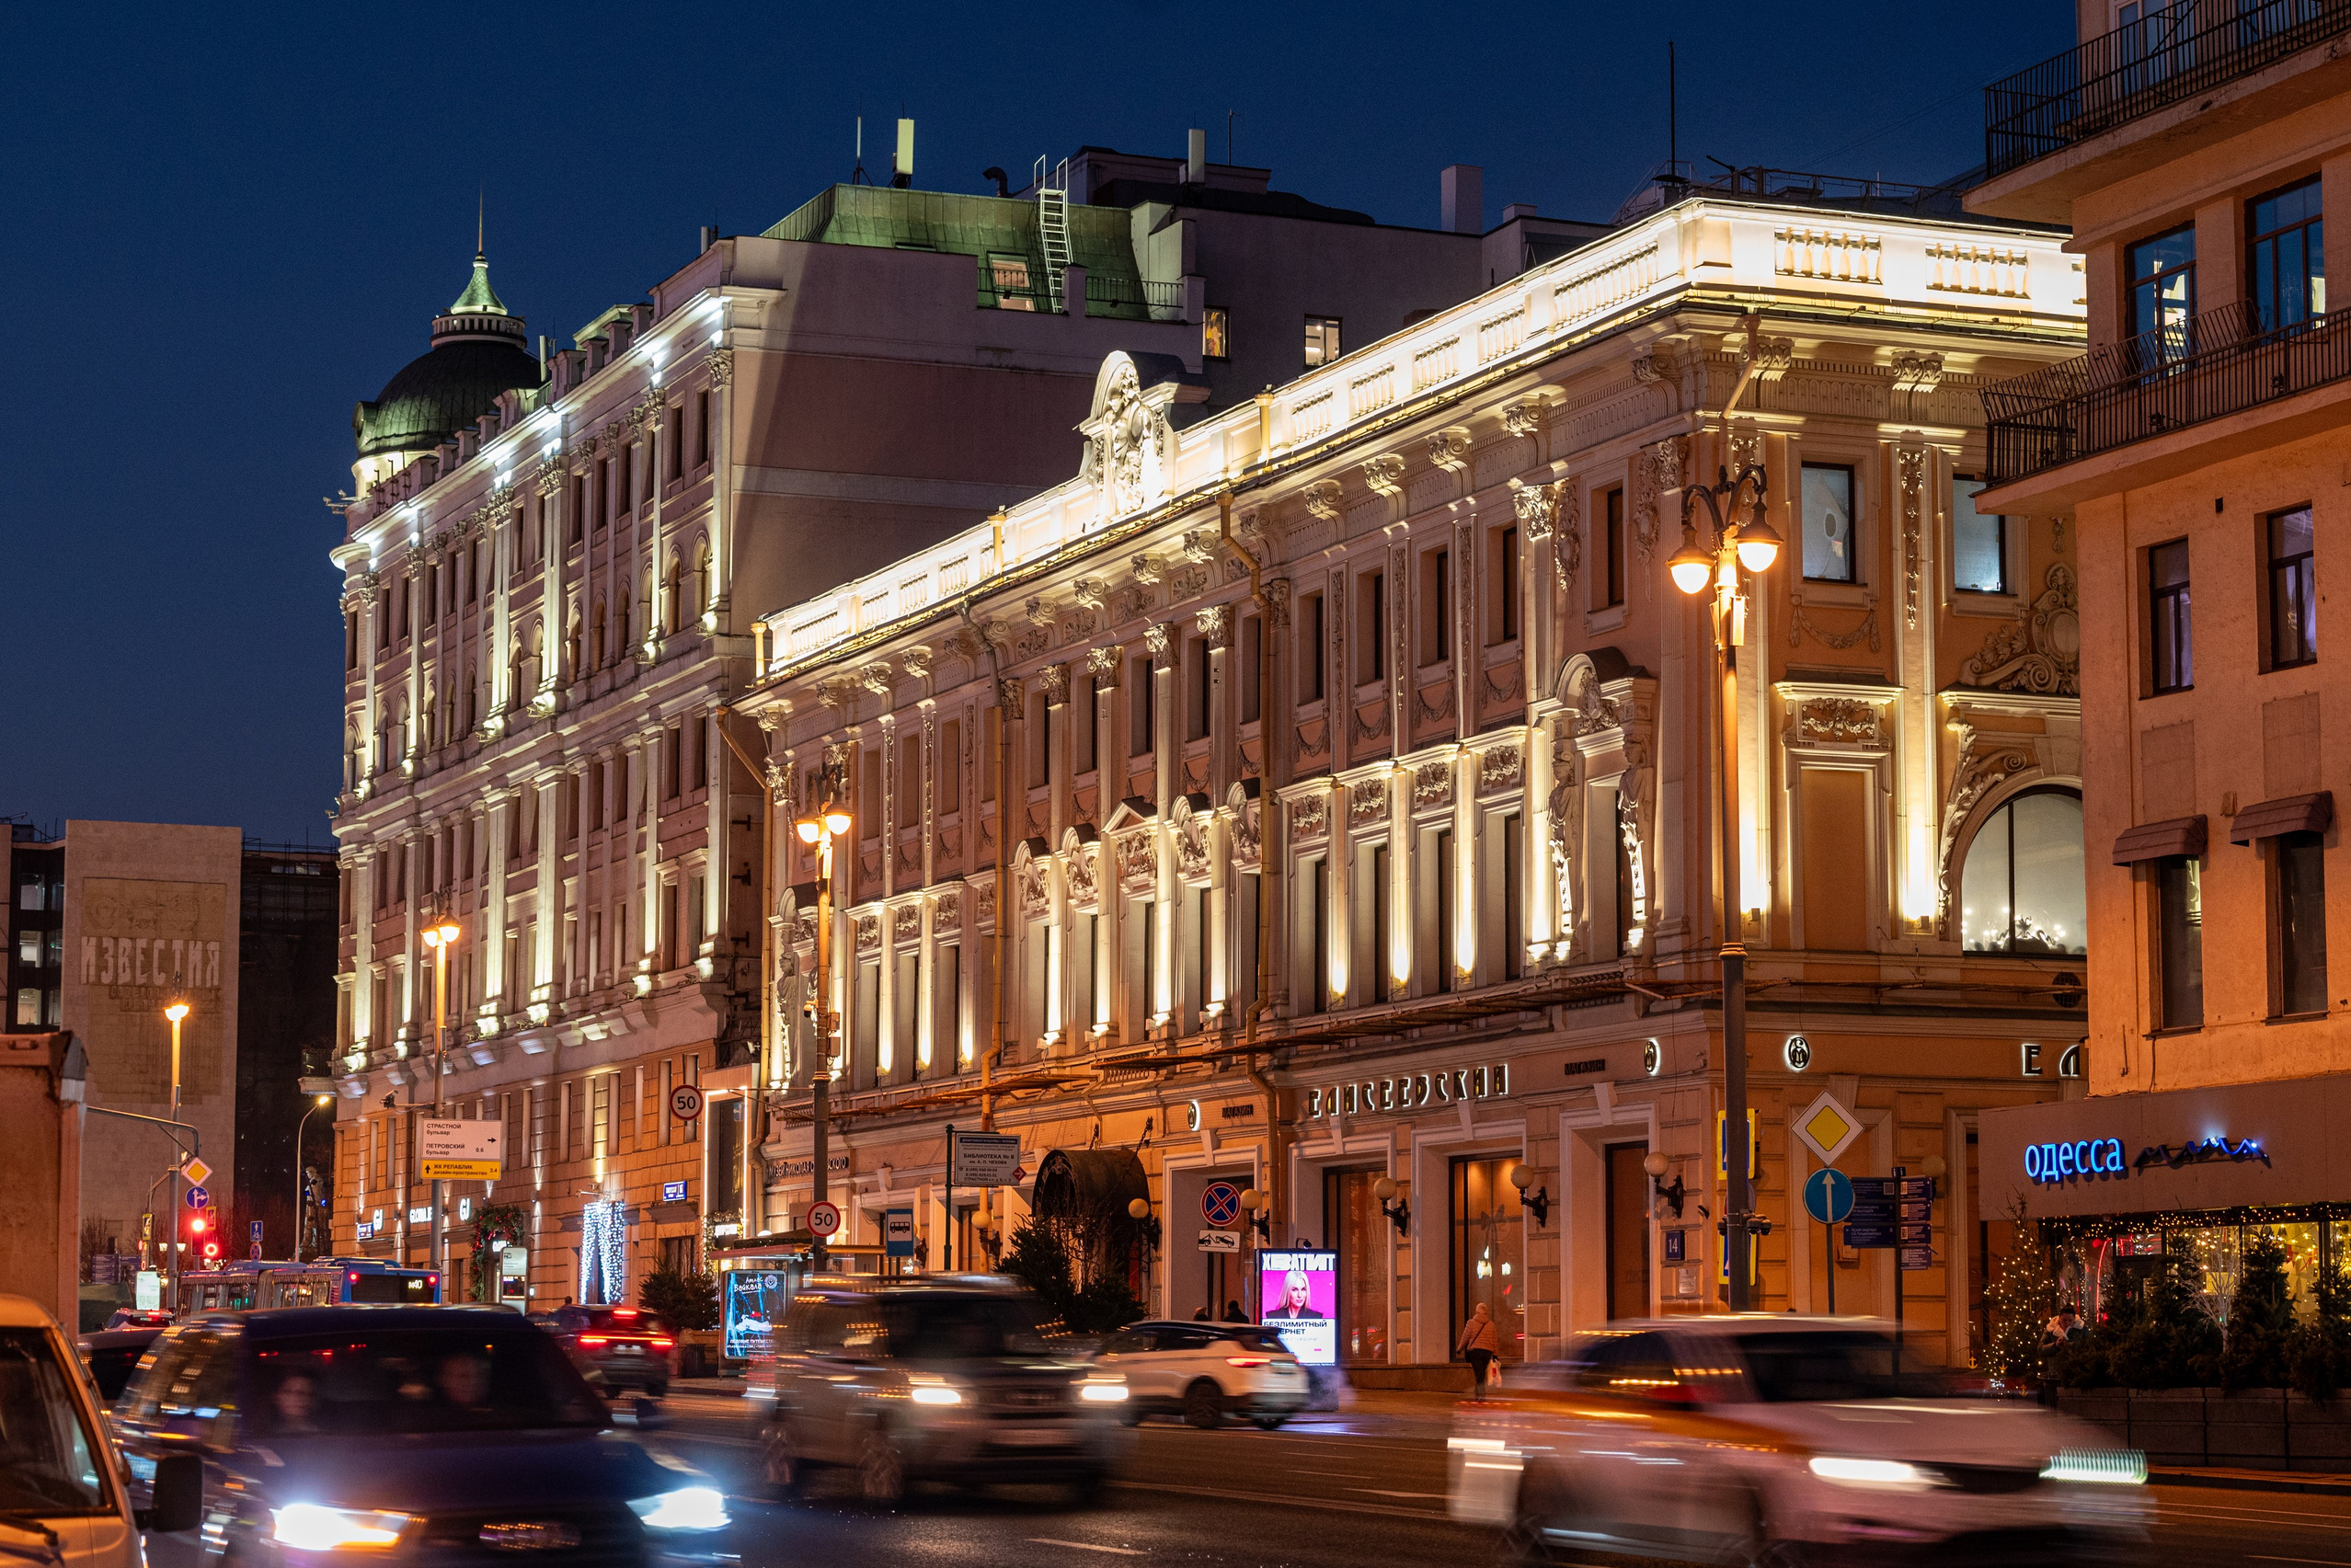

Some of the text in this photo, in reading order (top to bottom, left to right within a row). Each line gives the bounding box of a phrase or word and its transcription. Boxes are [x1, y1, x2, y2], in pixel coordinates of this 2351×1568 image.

[80, 936, 220, 988] ИЗВЕСТИЯ
[677, 1095, 696, 1110] 50
[2024, 1138, 2125, 1183] одесса
[814, 1212, 833, 1227] 50
[1668, 1238, 1679, 1253] 14
[733, 1283, 763, 1293] Байкала
[1264, 1319, 1327, 1328] БЕЗЛИМИТНЫЙ
